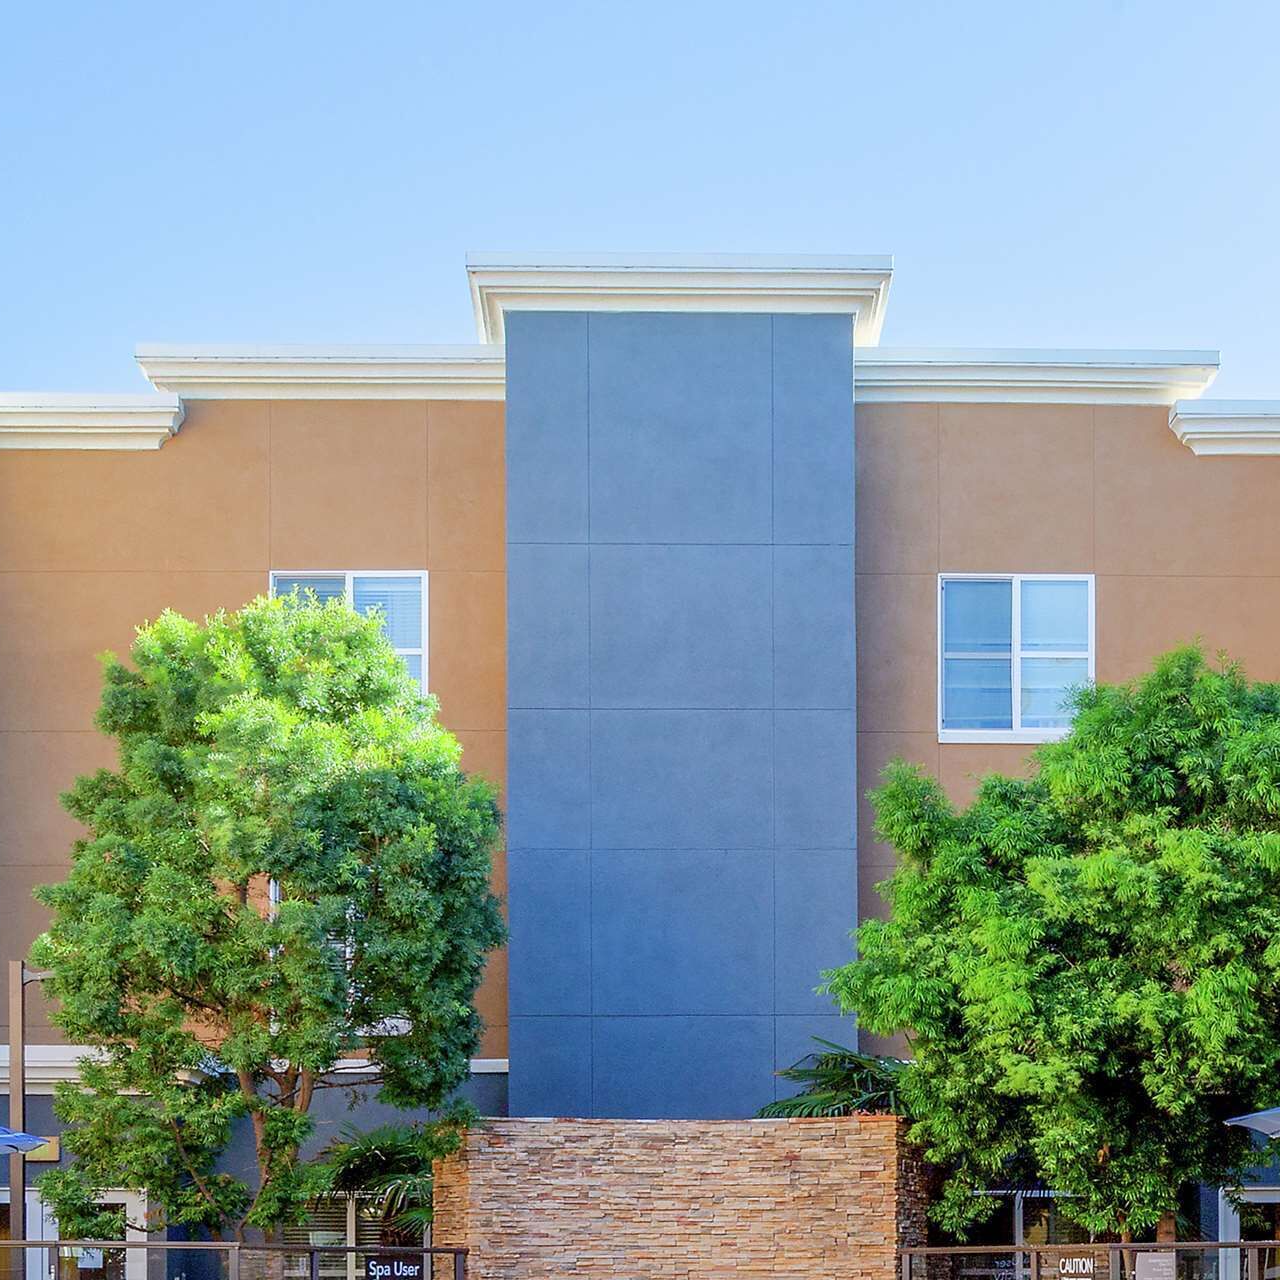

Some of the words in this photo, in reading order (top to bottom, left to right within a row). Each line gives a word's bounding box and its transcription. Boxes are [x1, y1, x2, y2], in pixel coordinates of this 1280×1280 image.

[369, 1261, 390, 1280] Spa
[394, 1261, 420, 1276] User
[1059, 1257, 1094, 1274] CAUTION
